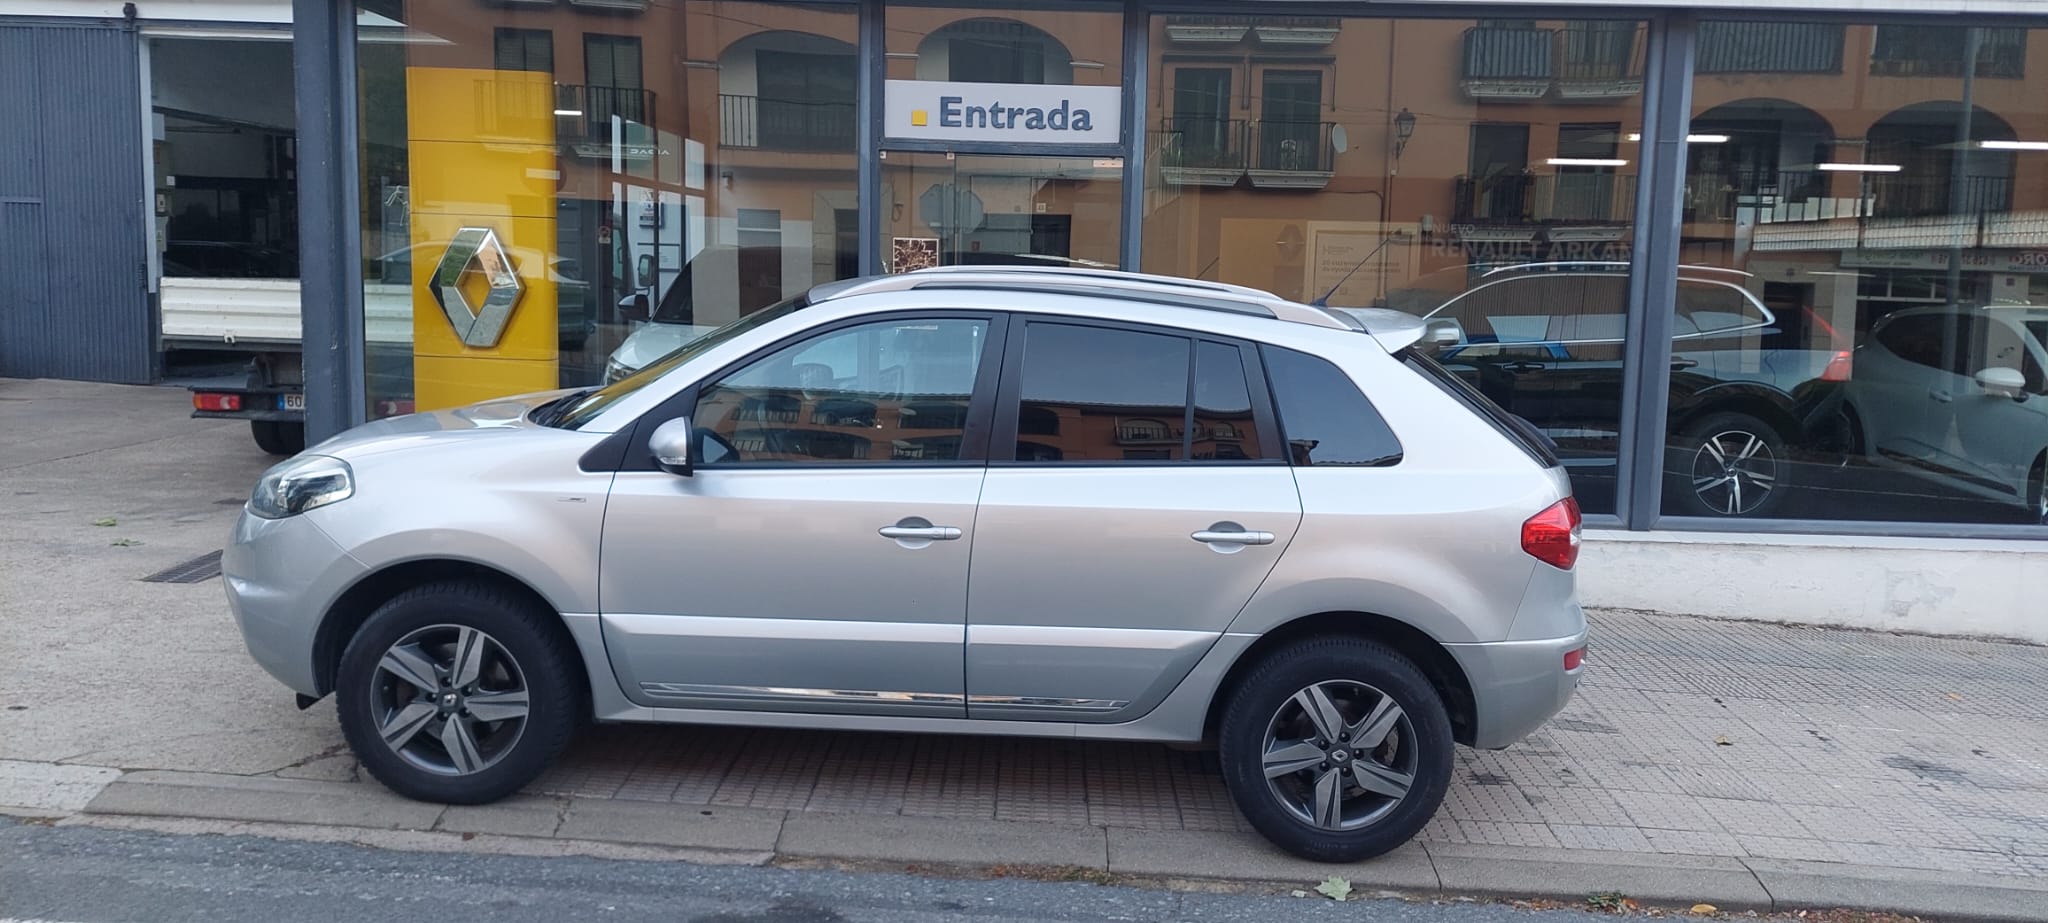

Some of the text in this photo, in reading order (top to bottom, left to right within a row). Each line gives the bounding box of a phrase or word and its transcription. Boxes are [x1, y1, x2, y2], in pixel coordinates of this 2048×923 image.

[939, 96, 1093, 131] Entrada
[1433, 223, 1475, 234] NUEVO
[1432, 239, 1543, 259] RENAULT
